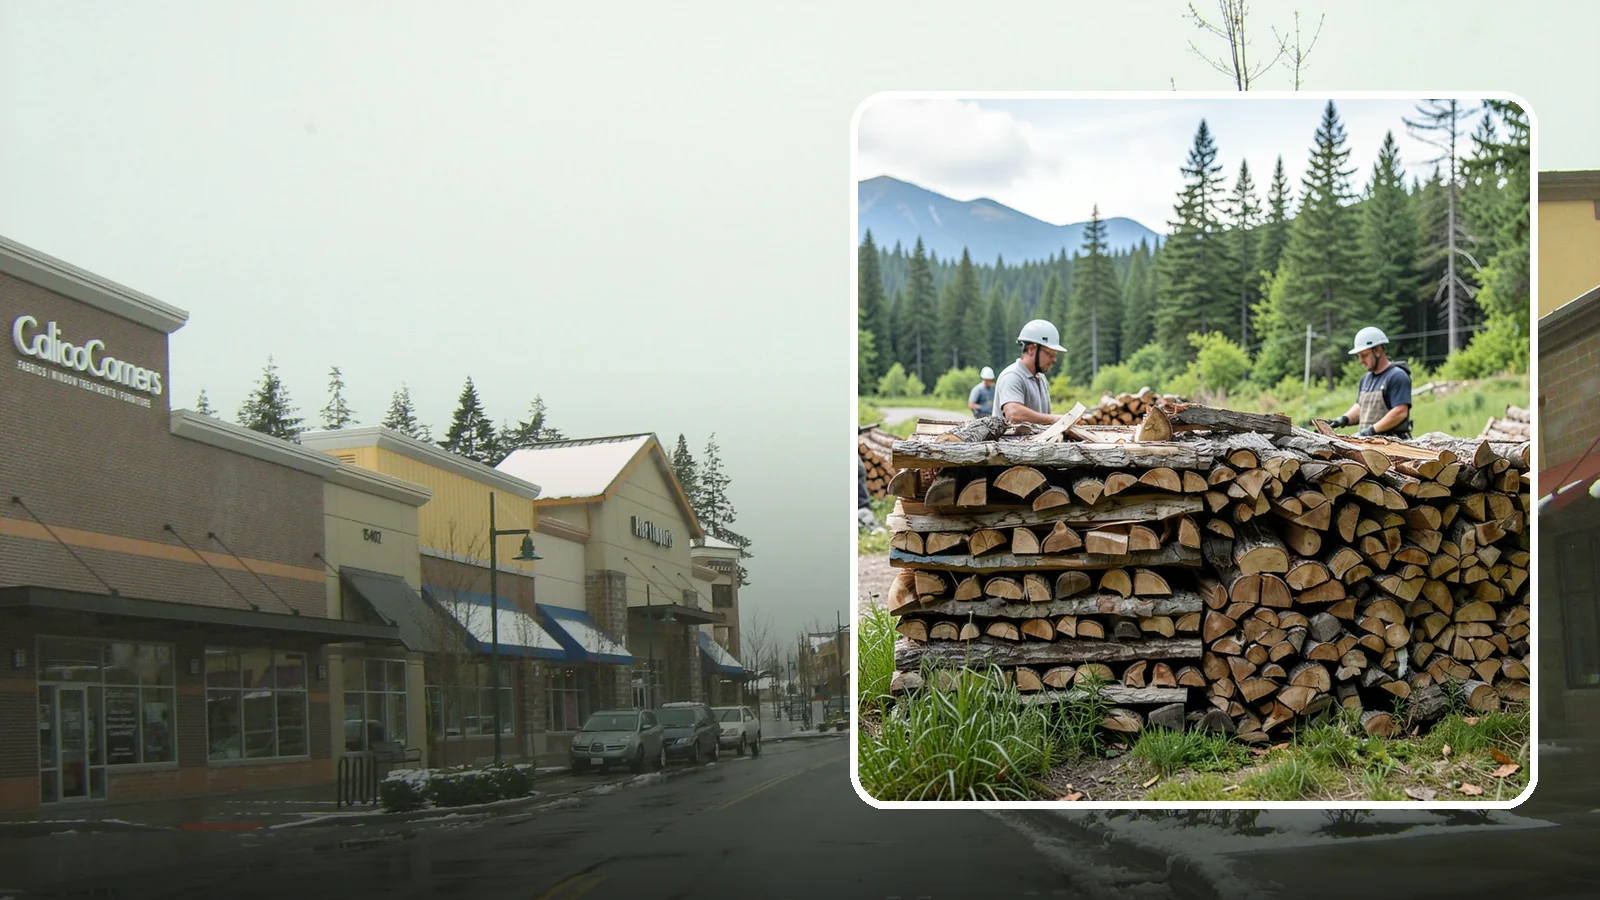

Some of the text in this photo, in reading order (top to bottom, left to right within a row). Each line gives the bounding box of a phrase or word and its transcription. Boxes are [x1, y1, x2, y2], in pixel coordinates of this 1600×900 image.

[17, 360, 47, 377] FABRICS
[51, 371, 78, 387] WINDOW
[79, 378, 117, 399] TREATMENTS
